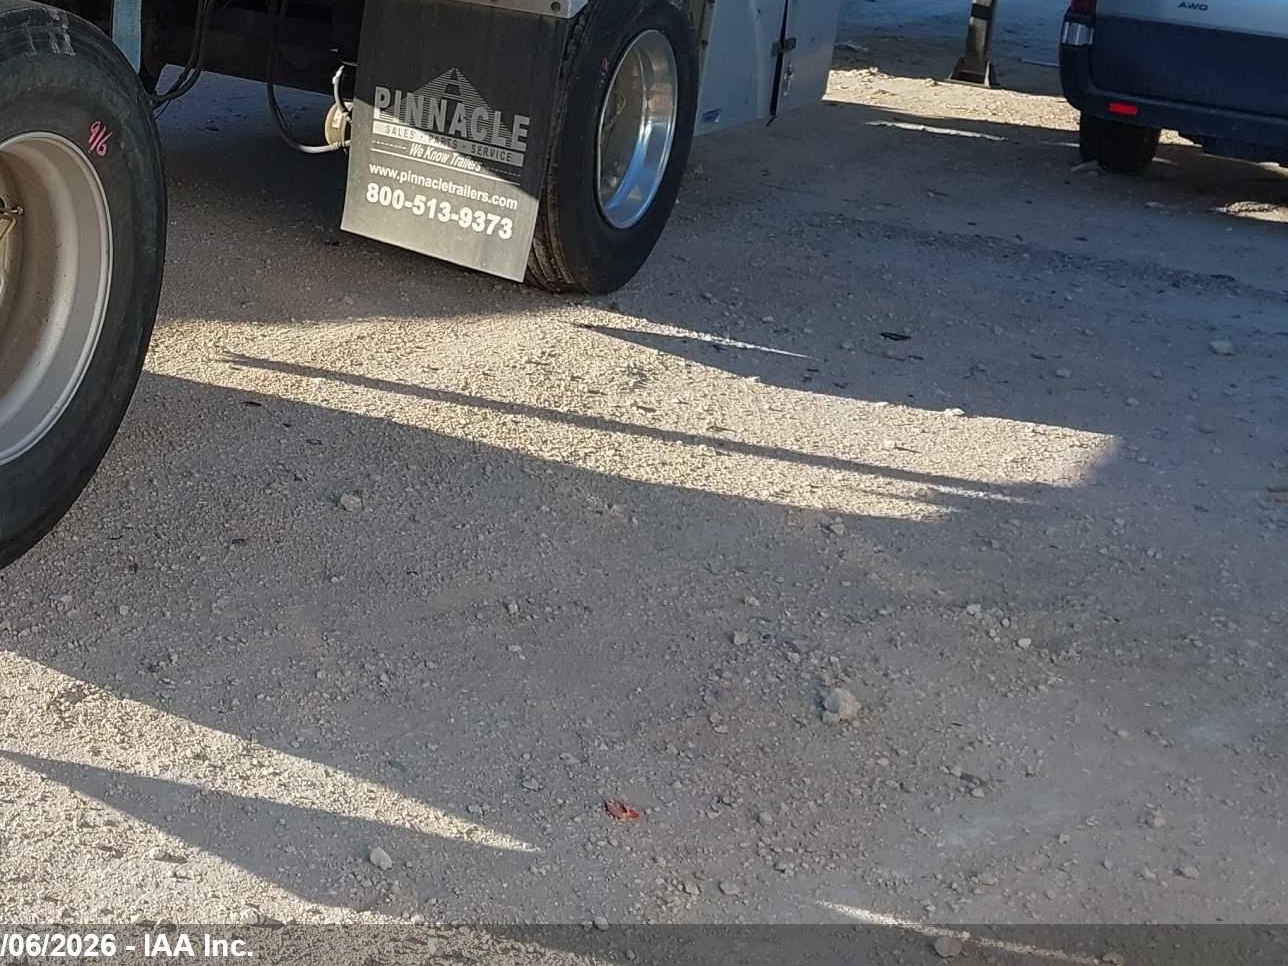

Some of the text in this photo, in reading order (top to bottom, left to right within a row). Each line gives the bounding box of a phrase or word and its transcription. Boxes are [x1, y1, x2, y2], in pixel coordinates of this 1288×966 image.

[1177, 1, 1208, 11] AWD
[373, 86, 531, 152] PINNACLE
[385, 125, 513, 162] SALES PARTS SERVICE
[409, 142, 482, 172] We Know Trailers
[369, 163, 518, 211] www.pinnacletrailers.com
[366, 182, 513, 240] 800-513-9373
